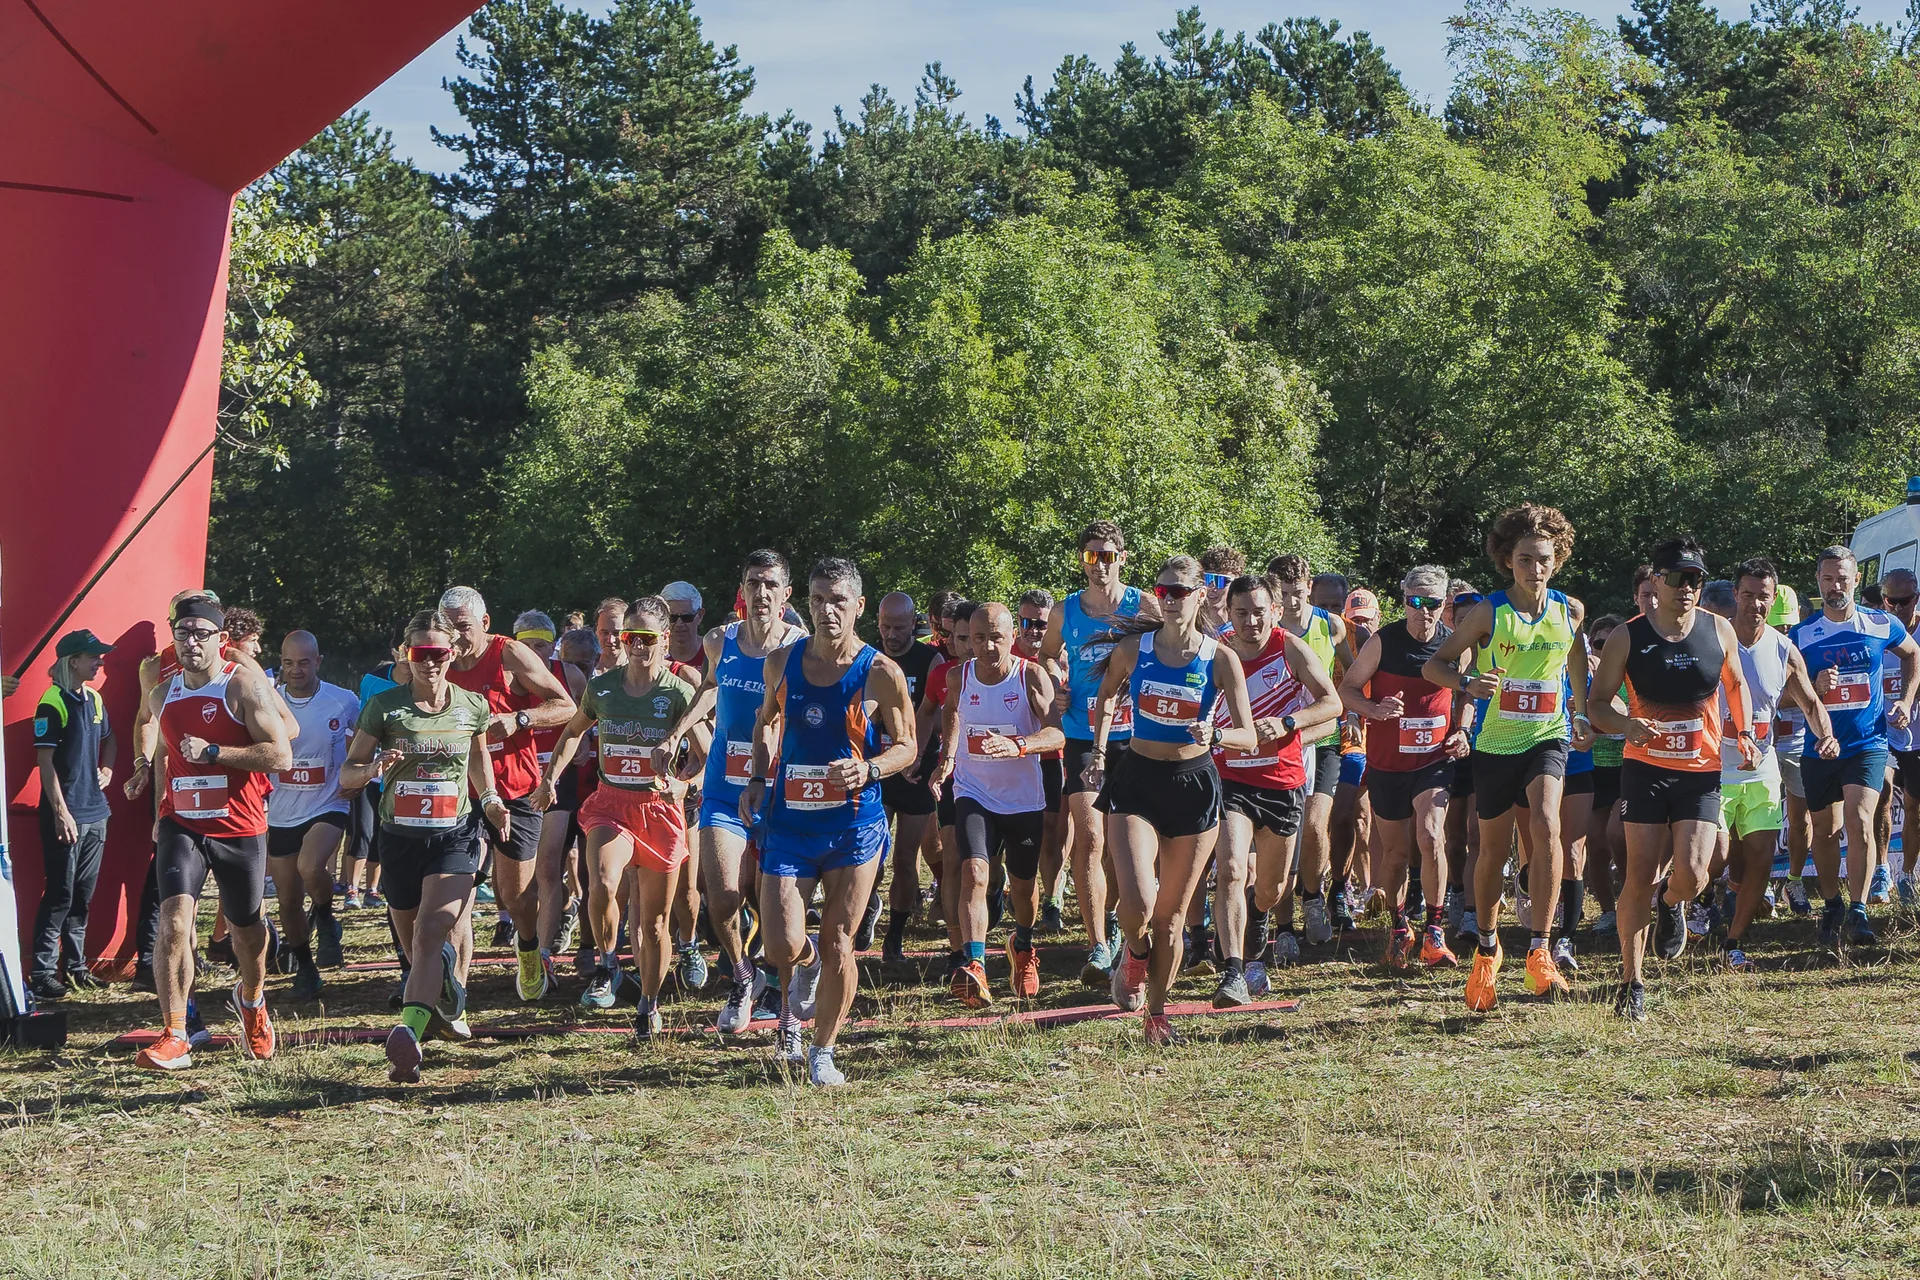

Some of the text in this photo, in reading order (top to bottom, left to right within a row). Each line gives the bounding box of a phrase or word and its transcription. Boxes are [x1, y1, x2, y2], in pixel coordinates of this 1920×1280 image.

[727, 677, 767, 690] ATLETIC
[1840, 687, 1850, 701] 5
[1157, 699, 1179, 716] 54
[1518, 695, 1538, 710] 51
[1415, 731, 1433, 744] 35
[1665, 735, 1686, 749] 38
[621, 759, 641, 774] 25
[292, 770, 310, 783] 40
[802, 782, 825, 799] 23
[192, 791, 201, 808] 1
[420, 798, 432, 815] 2
